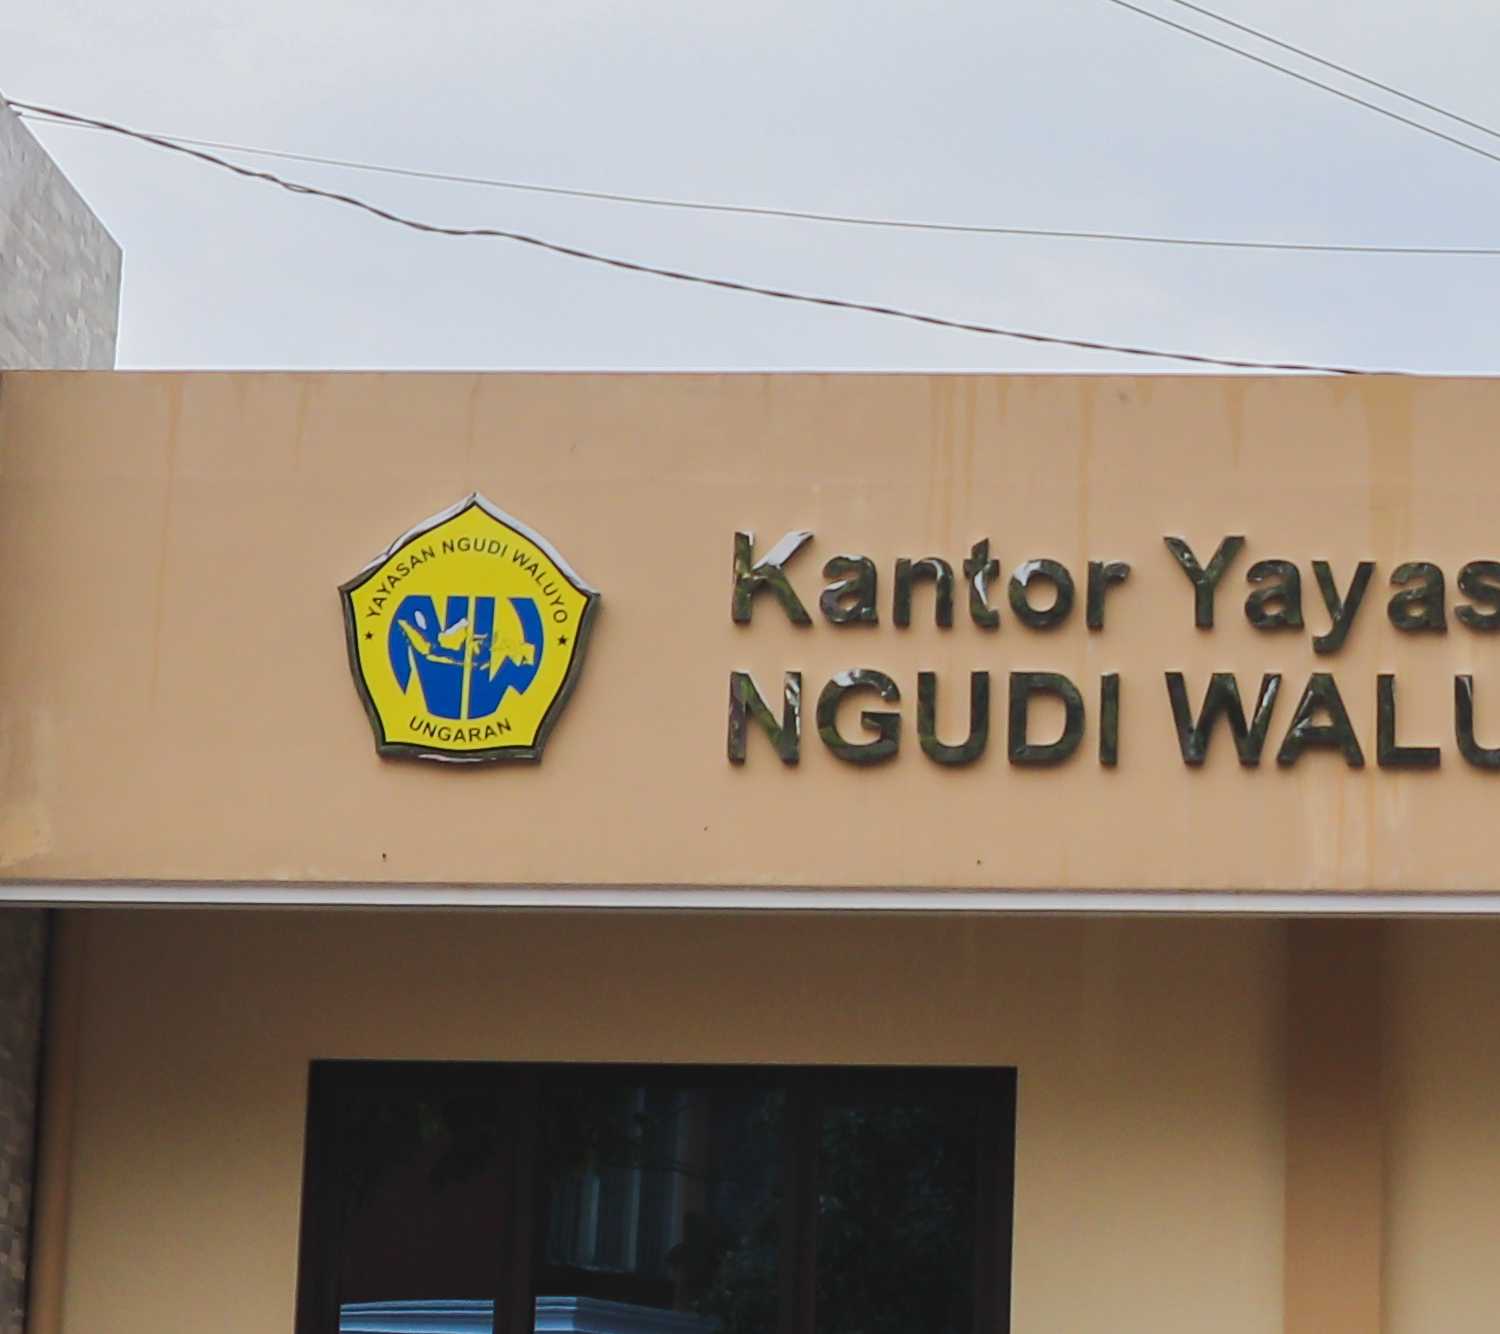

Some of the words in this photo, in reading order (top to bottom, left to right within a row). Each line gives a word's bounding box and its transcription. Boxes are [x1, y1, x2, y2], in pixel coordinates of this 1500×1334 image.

[366, 545, 436, 620] YAYASAN
[442, 537, 507, 557] NGUDI
[512, 549, 569, 625] WALUYO
[732, 530, 1132, 629] Kantor
[409, 716, 512, 743] UNGARAN
[728, 668, 1119, 766] NGUDI
